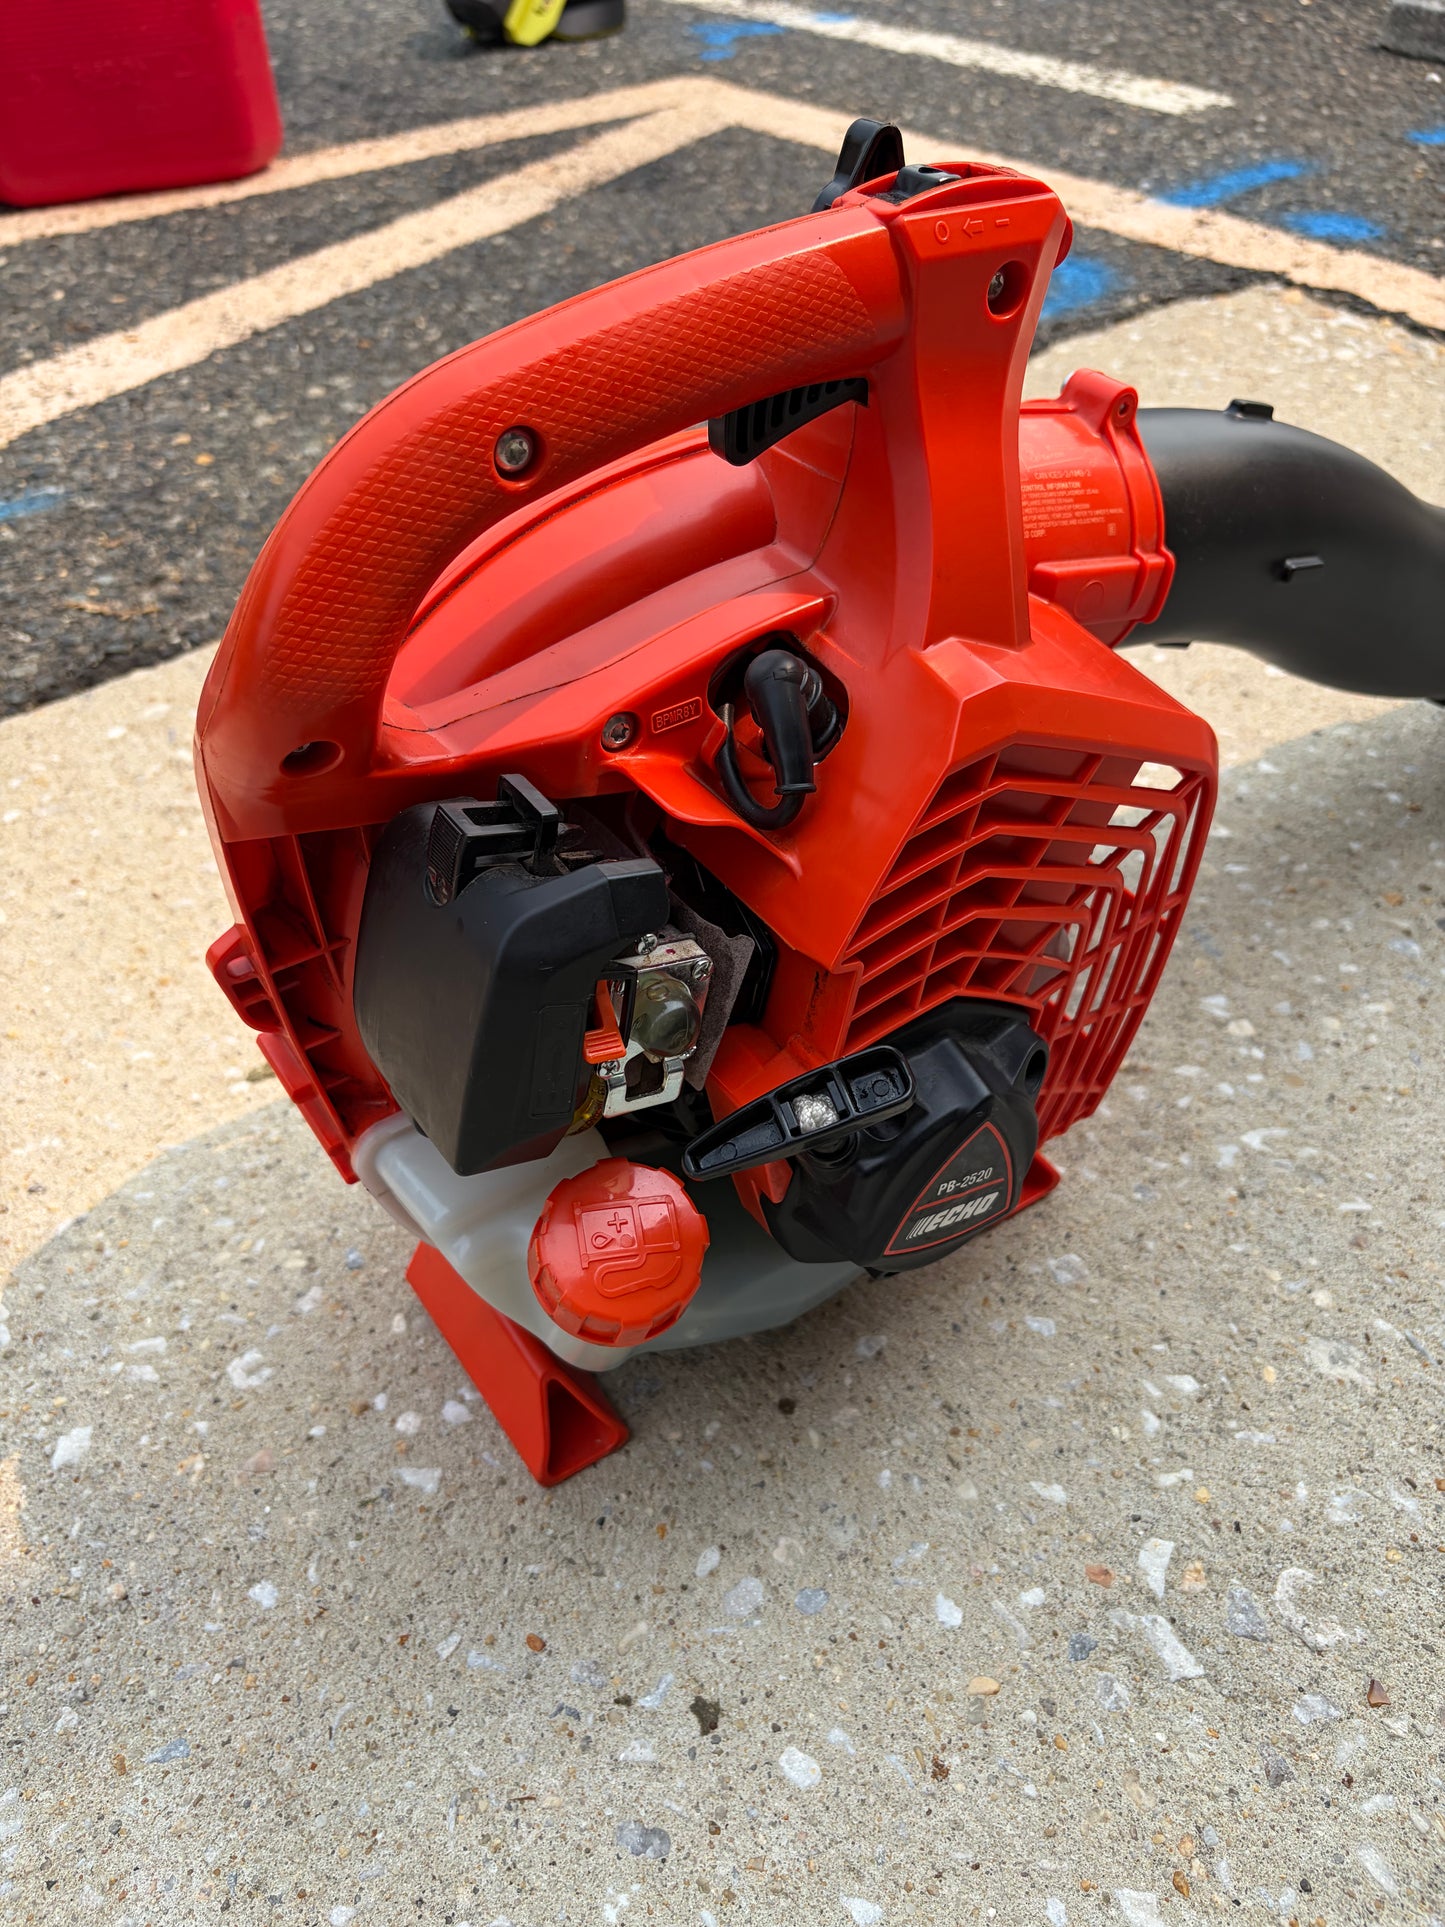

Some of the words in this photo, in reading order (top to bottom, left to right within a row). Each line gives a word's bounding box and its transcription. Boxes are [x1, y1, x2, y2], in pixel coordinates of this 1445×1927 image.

[656, 703, 696, 728] BPMR8Y
[937, 1167, 993, 1195] PB-2520
[918, 1192, 999, 1236] ECHO
